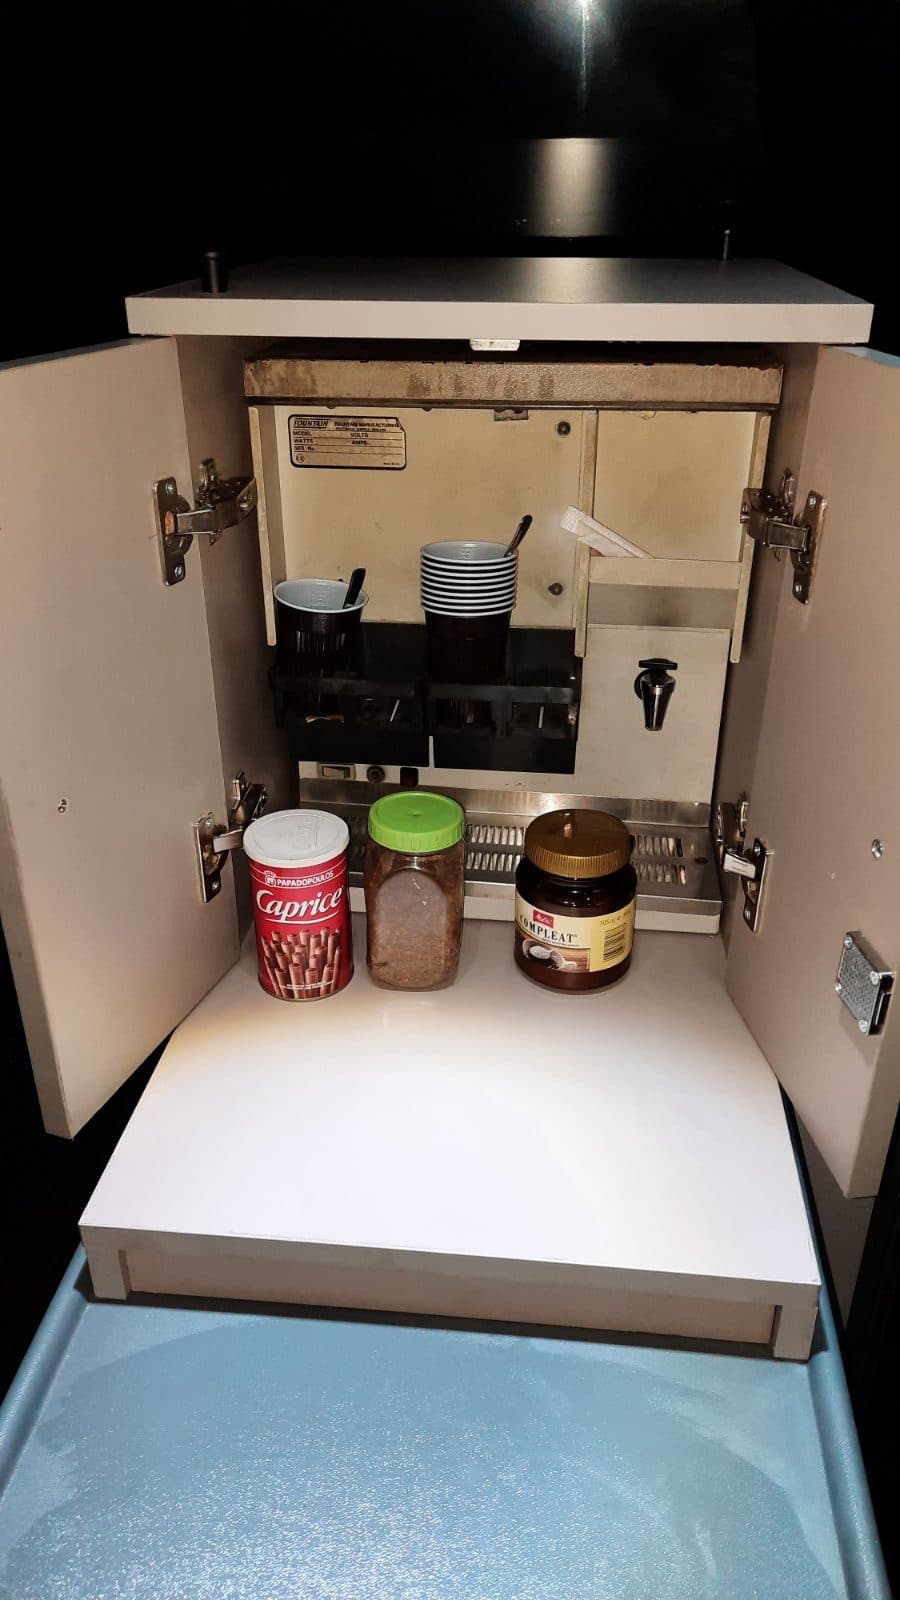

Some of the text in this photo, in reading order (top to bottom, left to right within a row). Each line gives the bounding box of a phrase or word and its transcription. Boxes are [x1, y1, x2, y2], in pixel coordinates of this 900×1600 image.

[293, 419, 328, 428] FOUNTAIN
[277, 871, 334, 887] PAPADOPOULOS
[256, 886, 343, 922] Caprice
